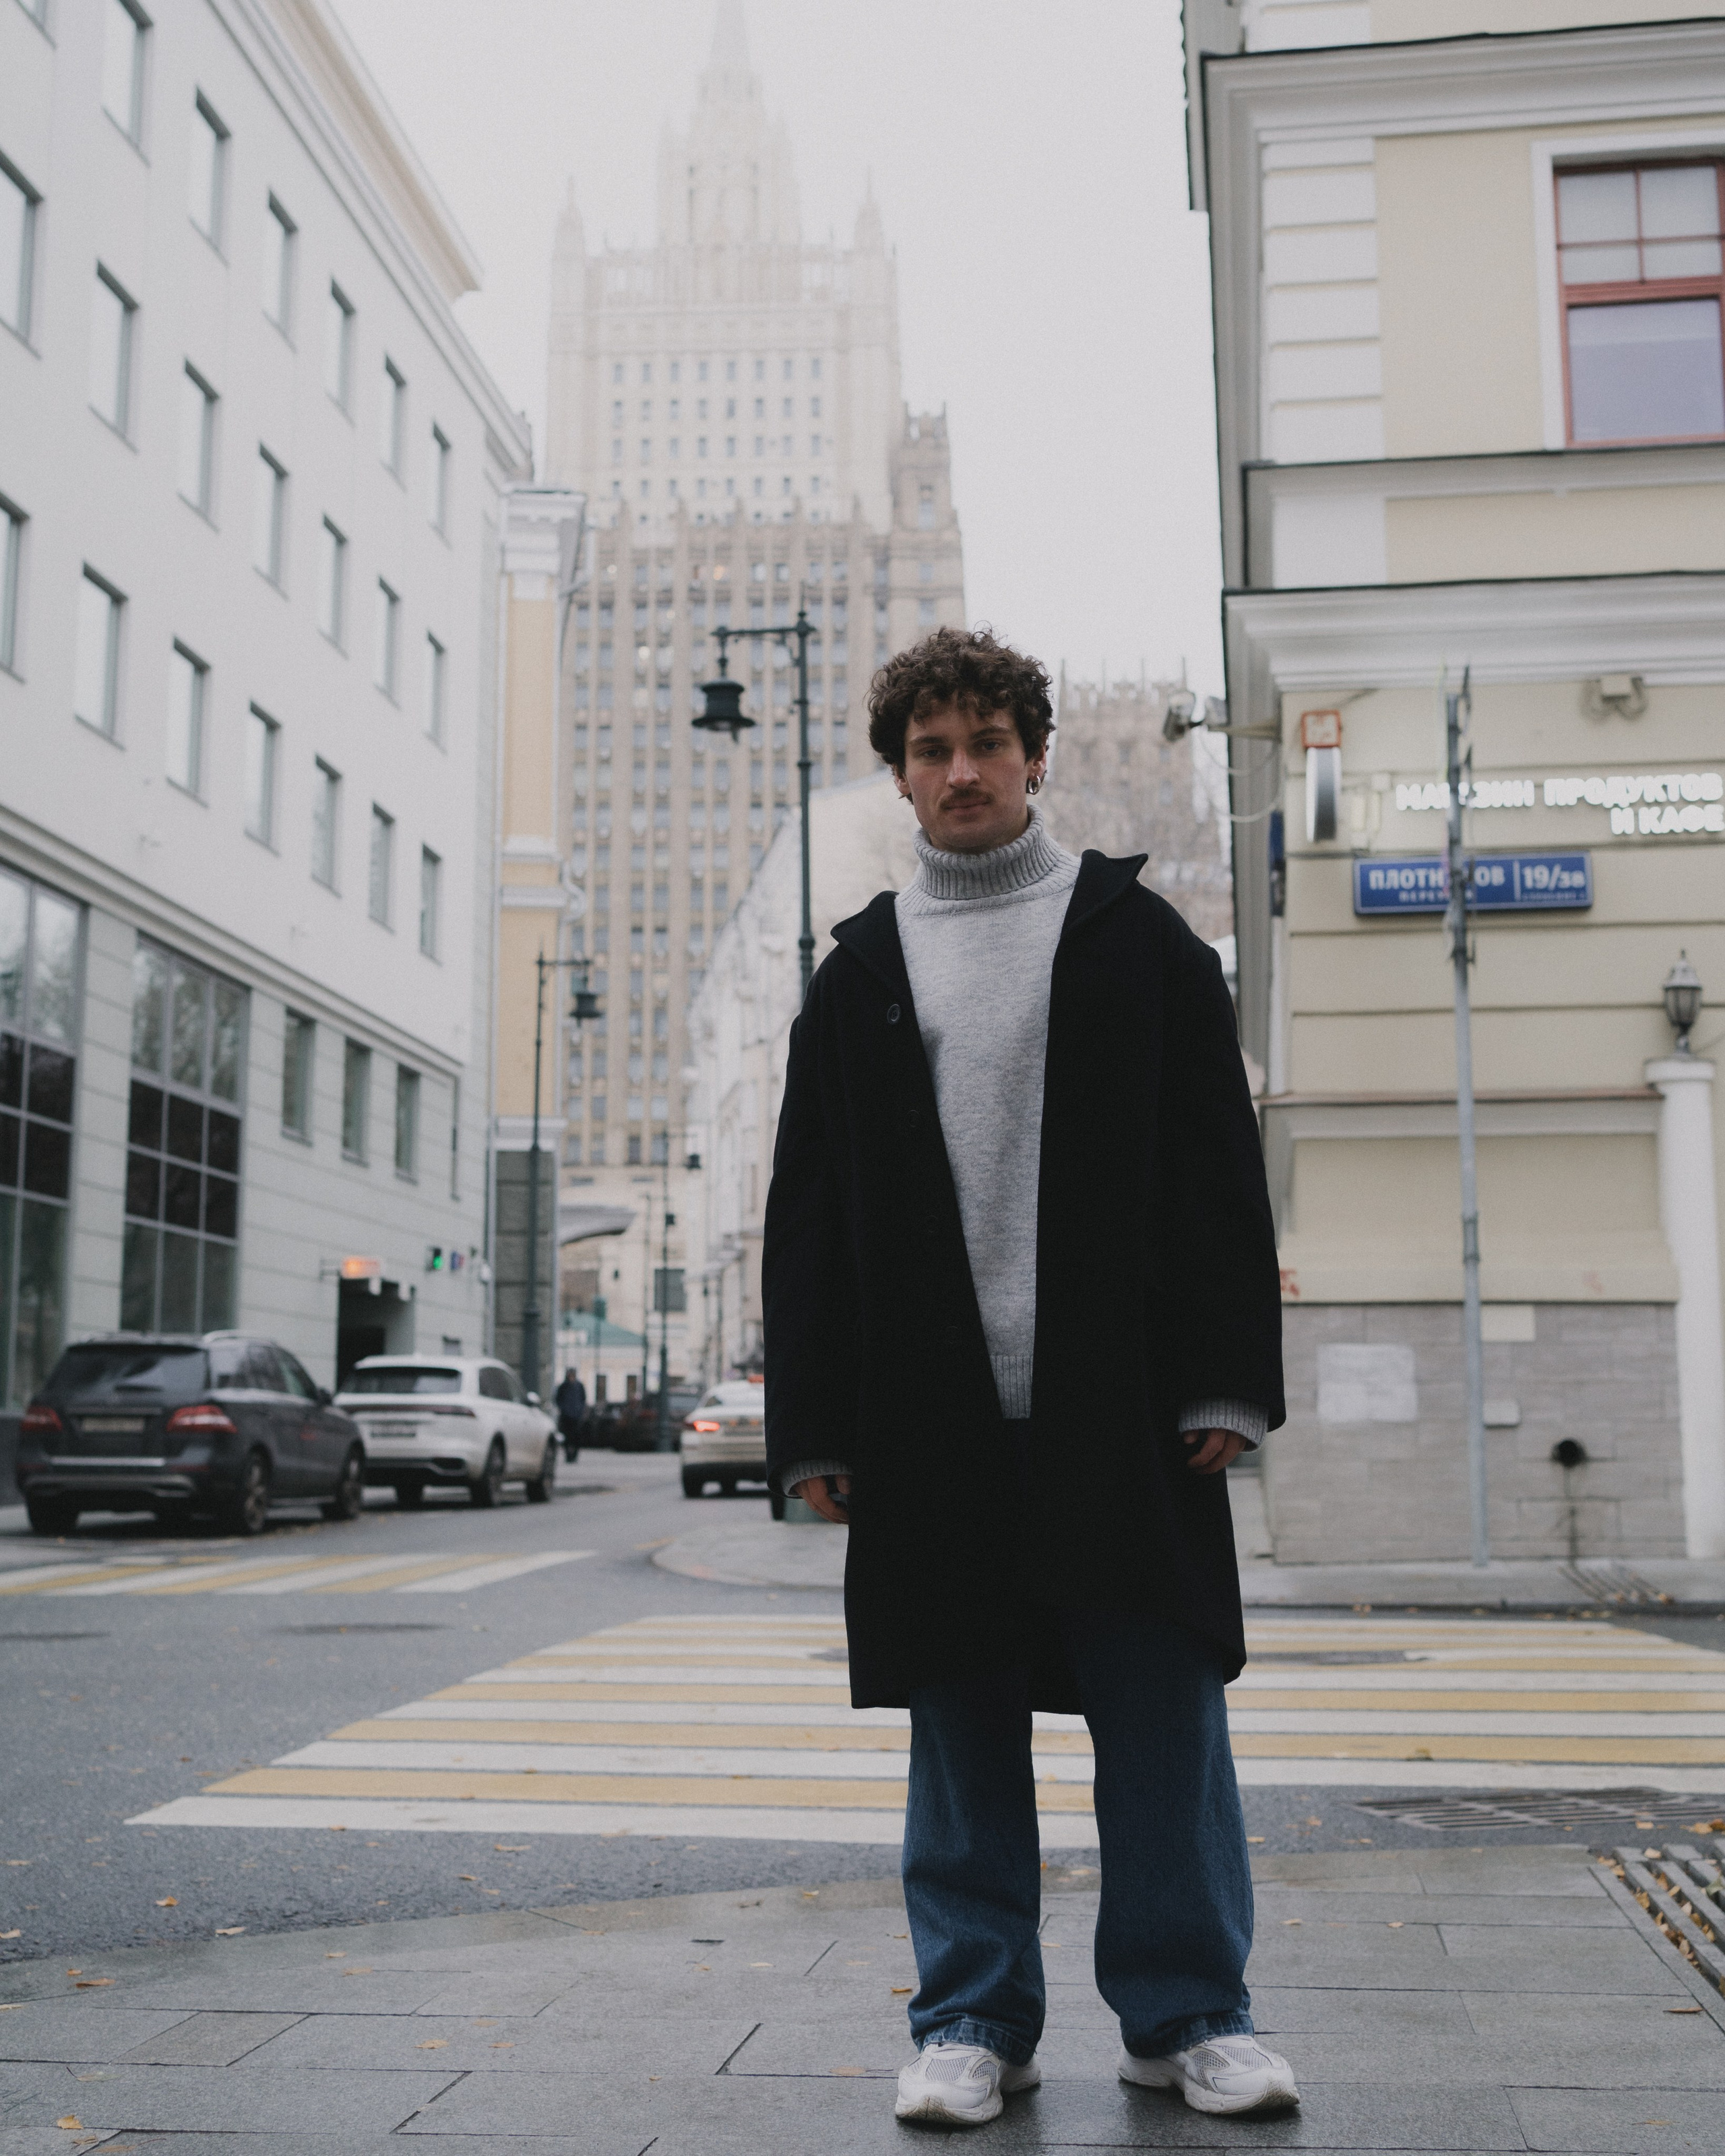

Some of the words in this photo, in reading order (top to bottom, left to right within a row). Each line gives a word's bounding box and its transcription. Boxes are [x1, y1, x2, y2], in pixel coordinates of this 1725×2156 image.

[1544, 773, 1724, 808] ПРОДУКТОВ
[1610, 806, 1635, 835] И
[1638, 804, 1725, 834] КАФЕ
[1369, 866, 1505, 890] ПЛОТНОВ
